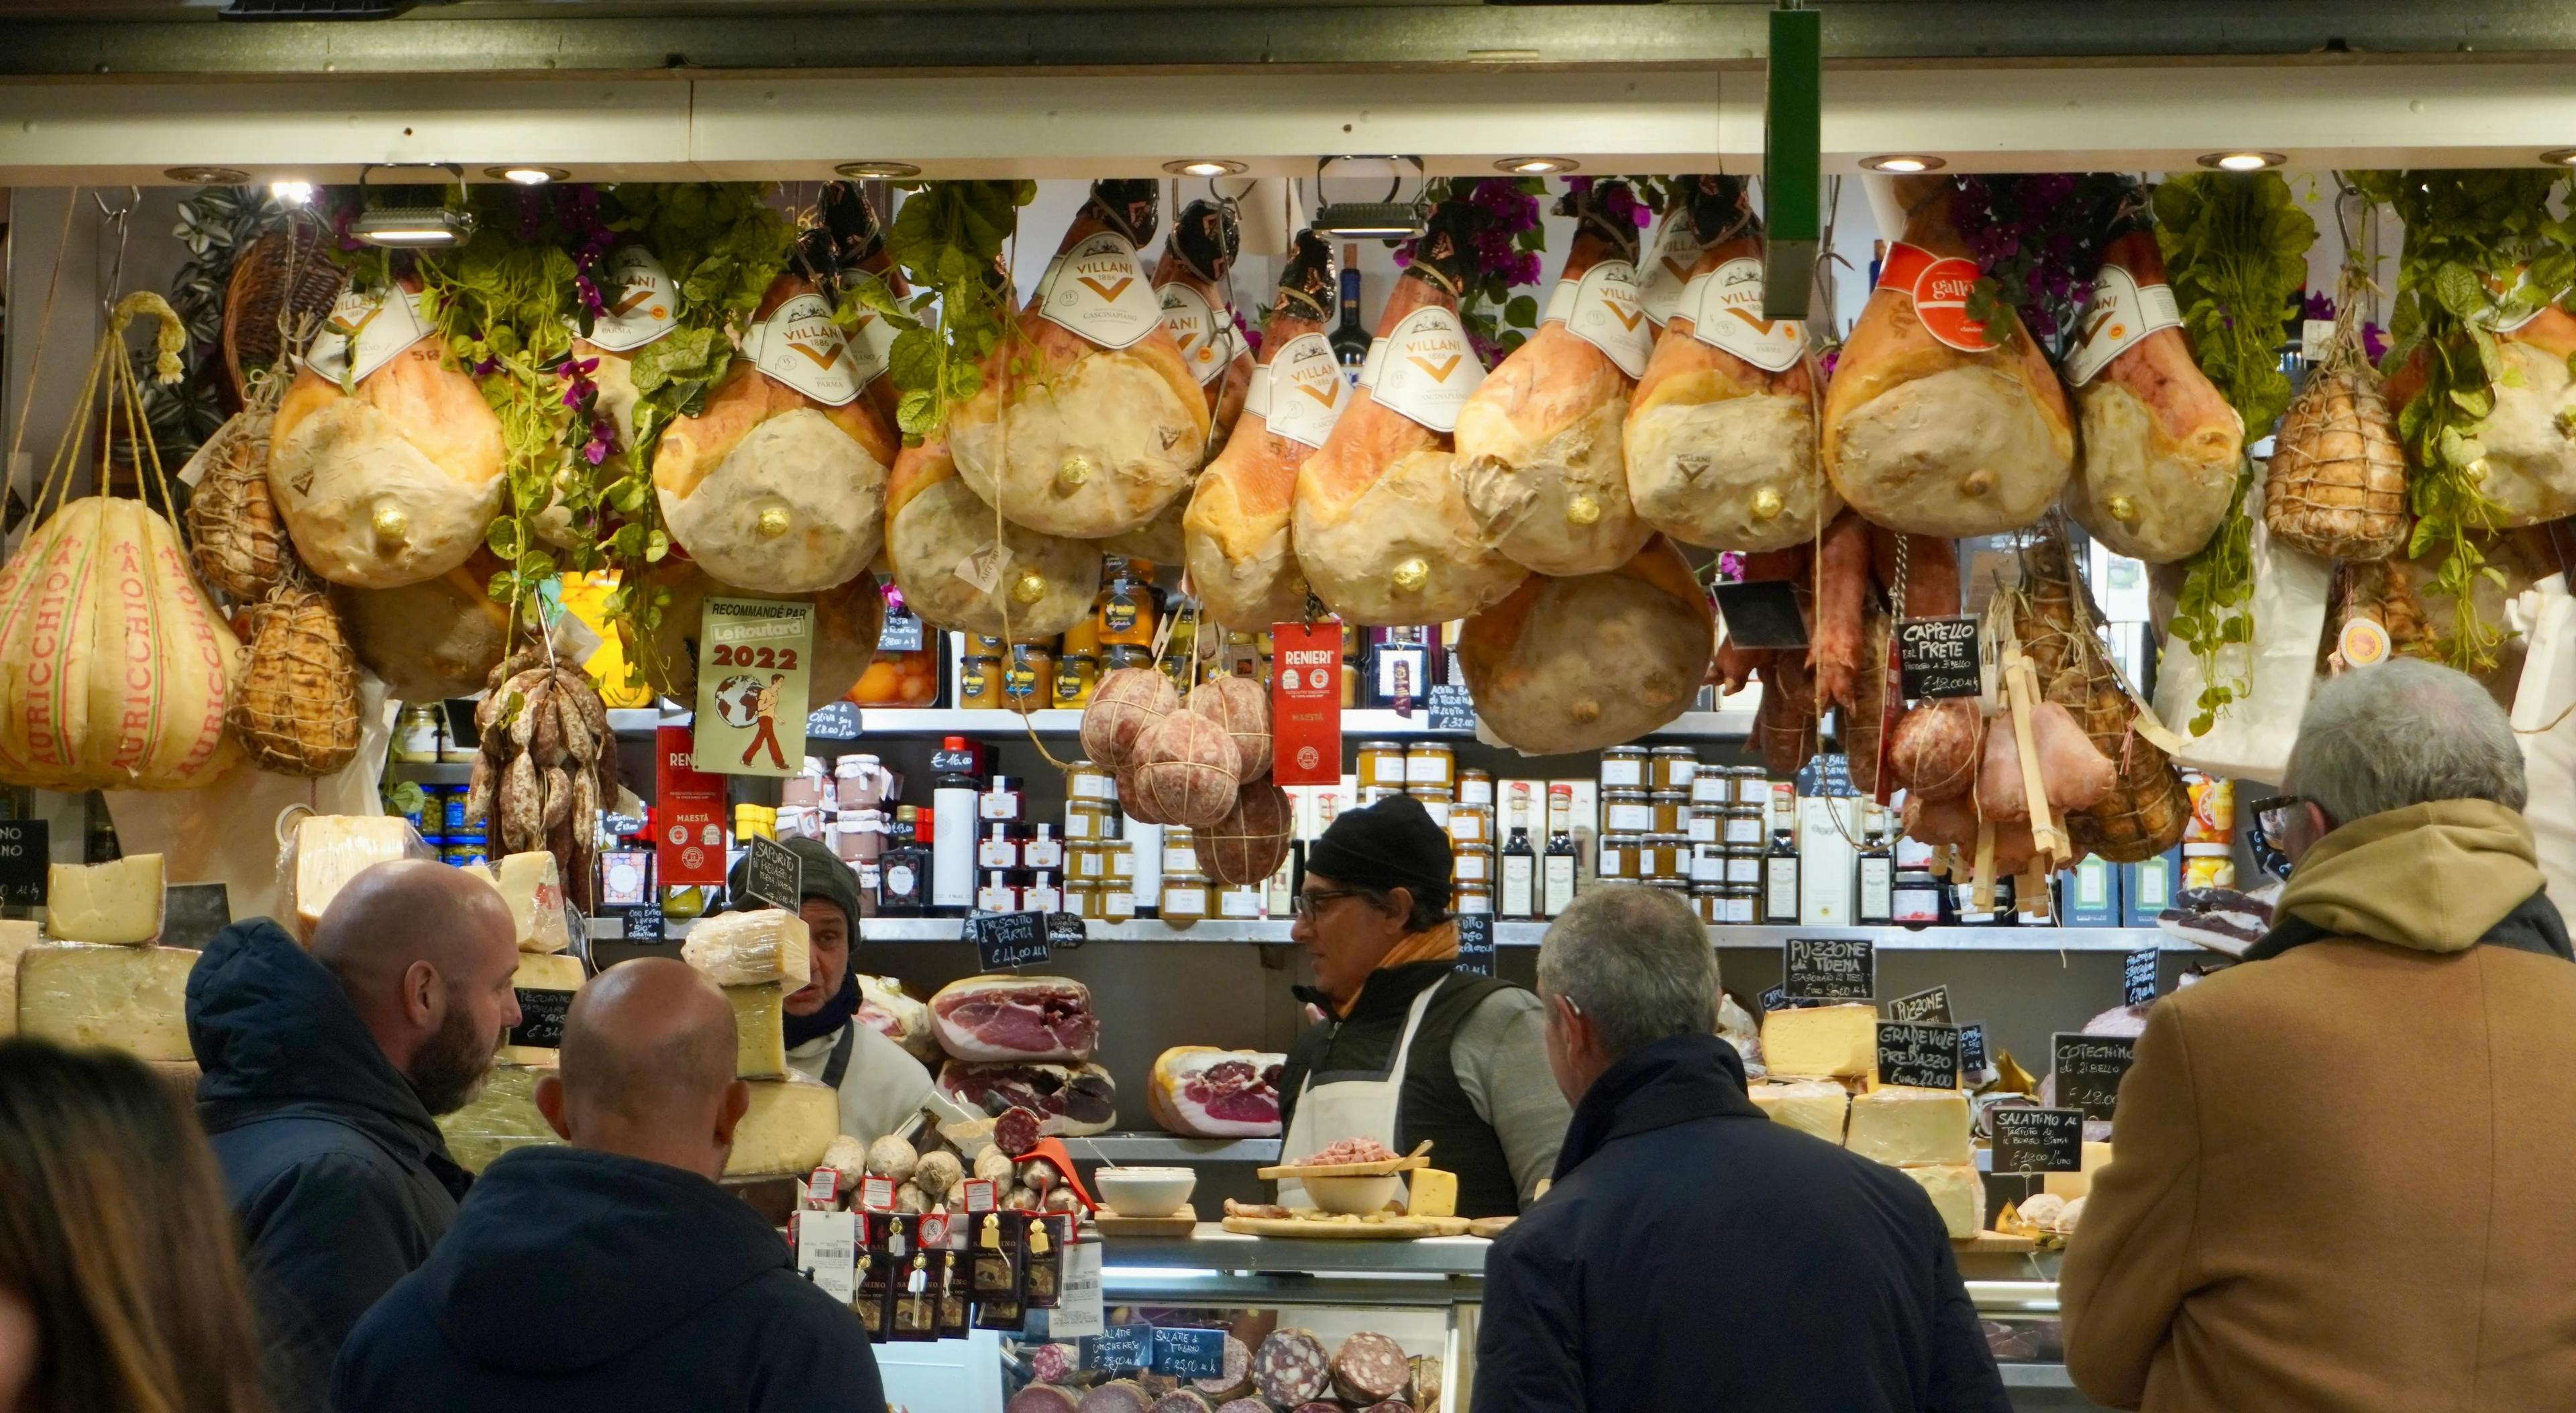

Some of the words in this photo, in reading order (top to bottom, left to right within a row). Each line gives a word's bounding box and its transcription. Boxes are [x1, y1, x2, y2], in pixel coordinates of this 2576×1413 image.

[1076, 262, 1133, 275] VILLANI
[810, 338, 830, 348] 1886
[1405, 339, 1462, 352] VILLANI
[1291, 363, 1336, 382] VILLAN
[816, 380, 844, 388] PARMA
[712, 603, 784, 619] RECOMMANDÉ
[786, 606, 807, 621] PAR
[1902, 621, 1974, 642] CAPPELLO
[711, 644, 798, 670] 2022
[1285, 650, 1332, 665] RENIERI
[1919, 641, 1964, 660] PRETE
[26, 572, 70, 767] AURICCHIO
[111, 578, 152, 770] AURICCHIO
[176, 586, 225, 776] AURICCHIO
[946, 753, 973, 766] 16.00
[676, 813, 710, 822] MAESTÀ
[755, 841, 794, 872] SAPORITO
[981, 914, 1033, 933] PROSCIUTTO
[1790, 940, 1869, 961] PUZZONE
[1812, 956, 1860, 973] MOENA
[1896, 992, 1944, 1021] PUZZONE
[1879, 1025, 1958, 1047] GRADEVOLE
[1878, 1046, 1952, 1070] PREDAZZO
[1996, 1112, 2059, 1127] SALAMINO
[2064, 1116, 2078, 1127] AL
[1093, 1328, 1132, 1341] SALAME
[1155, 1329, 1189, 1343] SALAME
[1093, 1341, 1140, 1353] UNGHERESE
